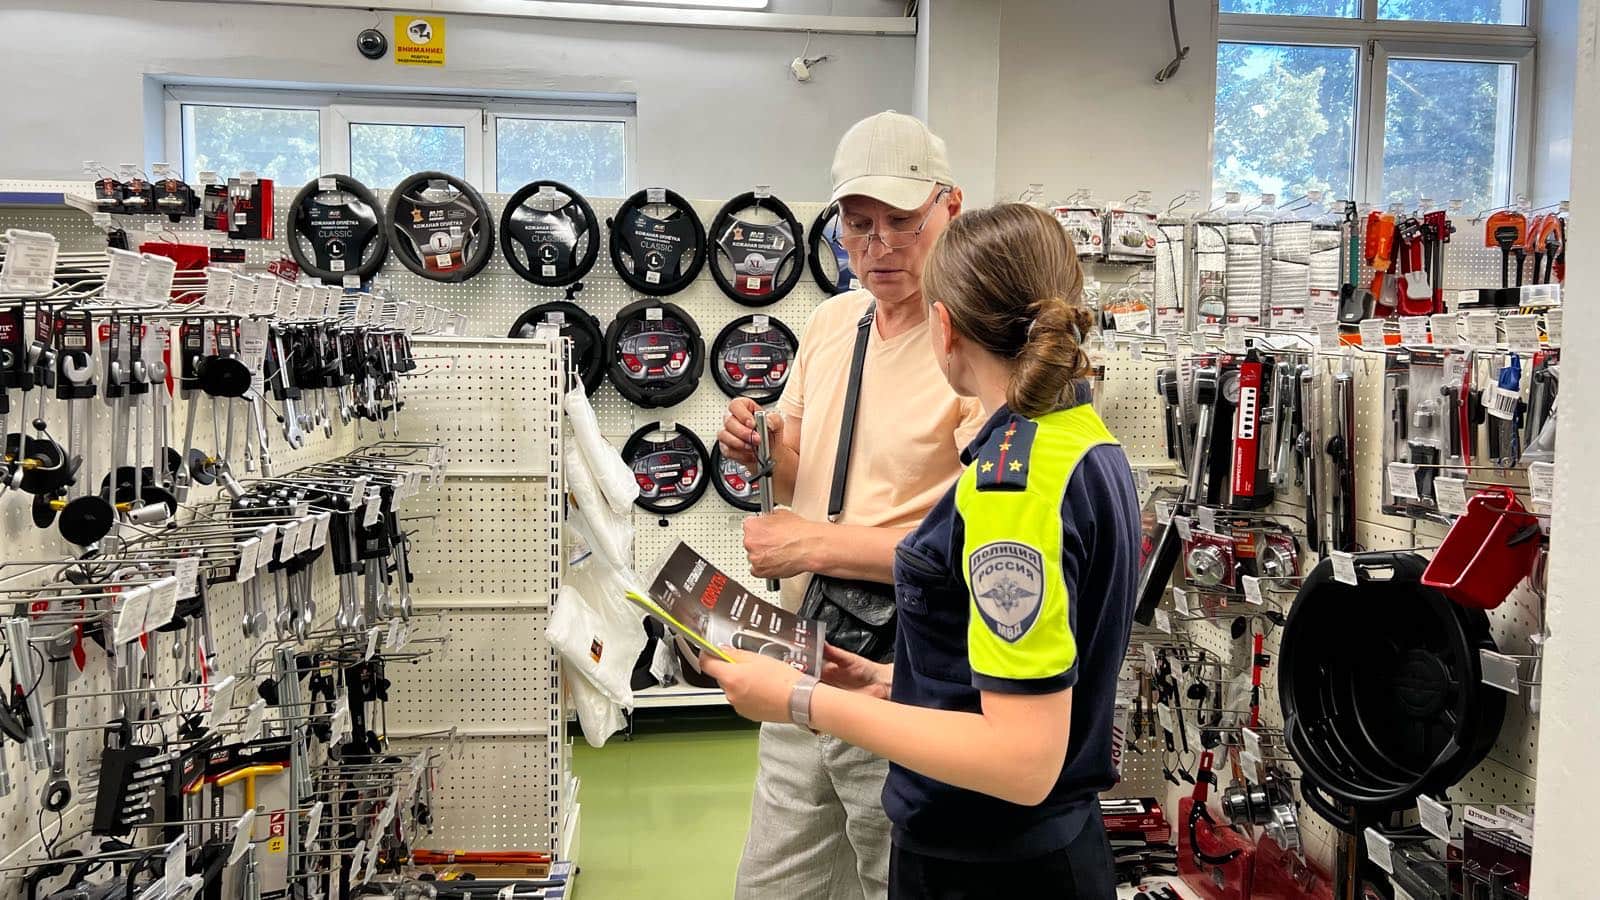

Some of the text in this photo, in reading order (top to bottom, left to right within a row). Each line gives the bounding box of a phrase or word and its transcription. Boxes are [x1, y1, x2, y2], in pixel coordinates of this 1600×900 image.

[397, 46, 443, 54] ВНИМАНИЕ!
[318, 230, 353, 238] CLASSIC
[438, 237, 448, 249] L
[640, 240, 674, 252] CLASSIC
[333, 244, 340, 253] L
[545, 249, 552, 258] L
[651, 256, 659, 265] L
[749, 259, 763, 268] XL
[973, 546, 1037, 565] ПОЛИЦИЯ
[978, 561, 1035, 582] РОССИЯ
